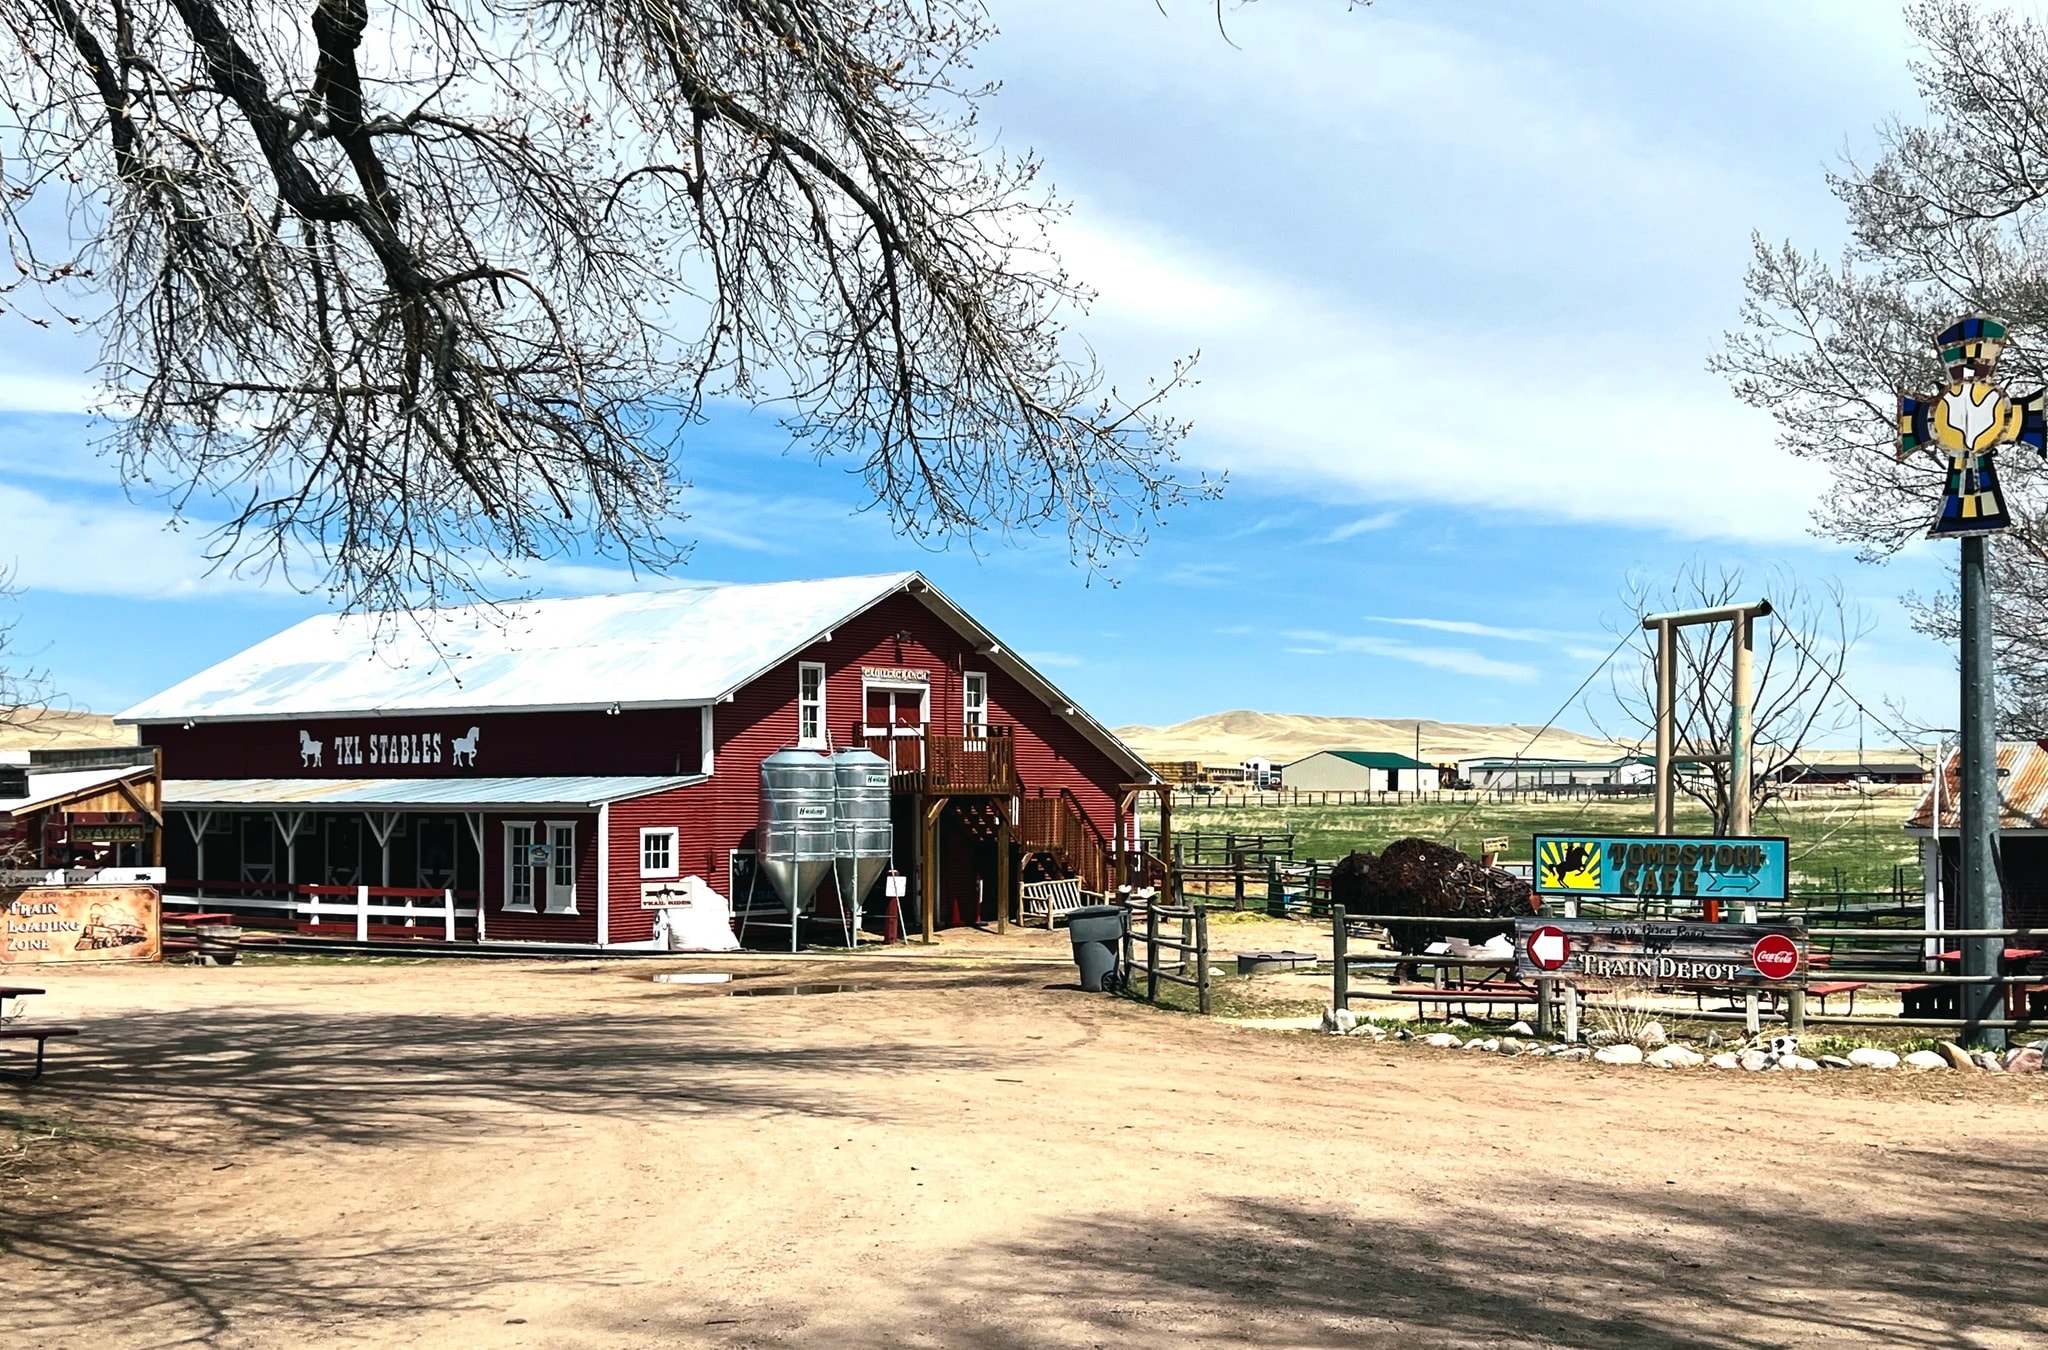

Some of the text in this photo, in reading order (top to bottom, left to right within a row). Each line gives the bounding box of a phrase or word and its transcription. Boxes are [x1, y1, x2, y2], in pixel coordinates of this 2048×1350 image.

[369, 732, 442, 764] STABLES
[74, 826, 140, 839] STATION
[1620, 868, 1699, 896] CAFE
